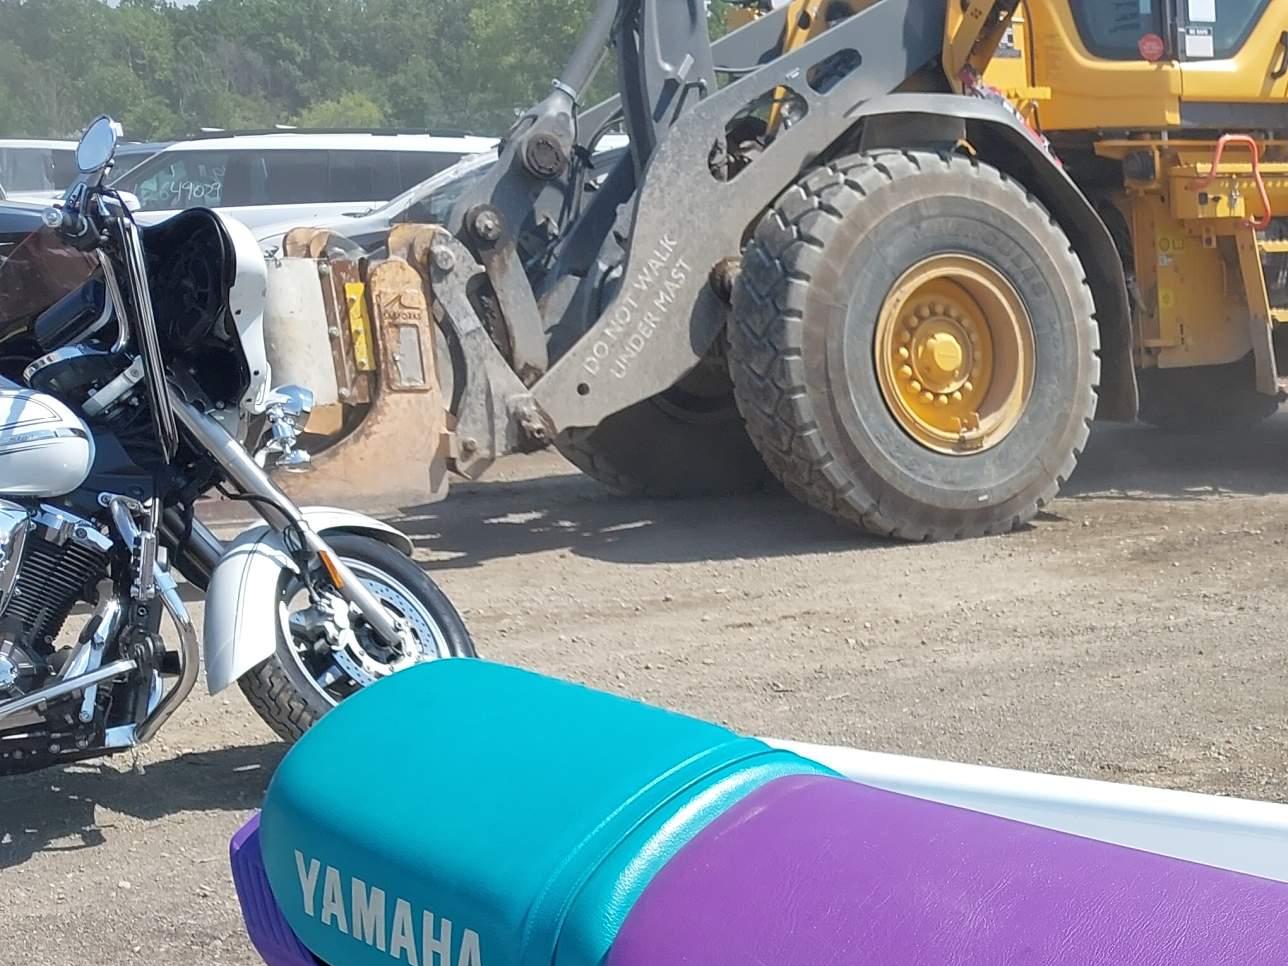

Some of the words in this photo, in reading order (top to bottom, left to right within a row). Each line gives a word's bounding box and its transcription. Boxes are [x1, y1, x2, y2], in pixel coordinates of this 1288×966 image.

[581, 339, 612, 375] DO
[603, 293, 640, 340] NOT
[632, 232, 678, 293] WALK
[608, 309, 662, 380] UNDER
[650, 256, 695, 313] MAST
